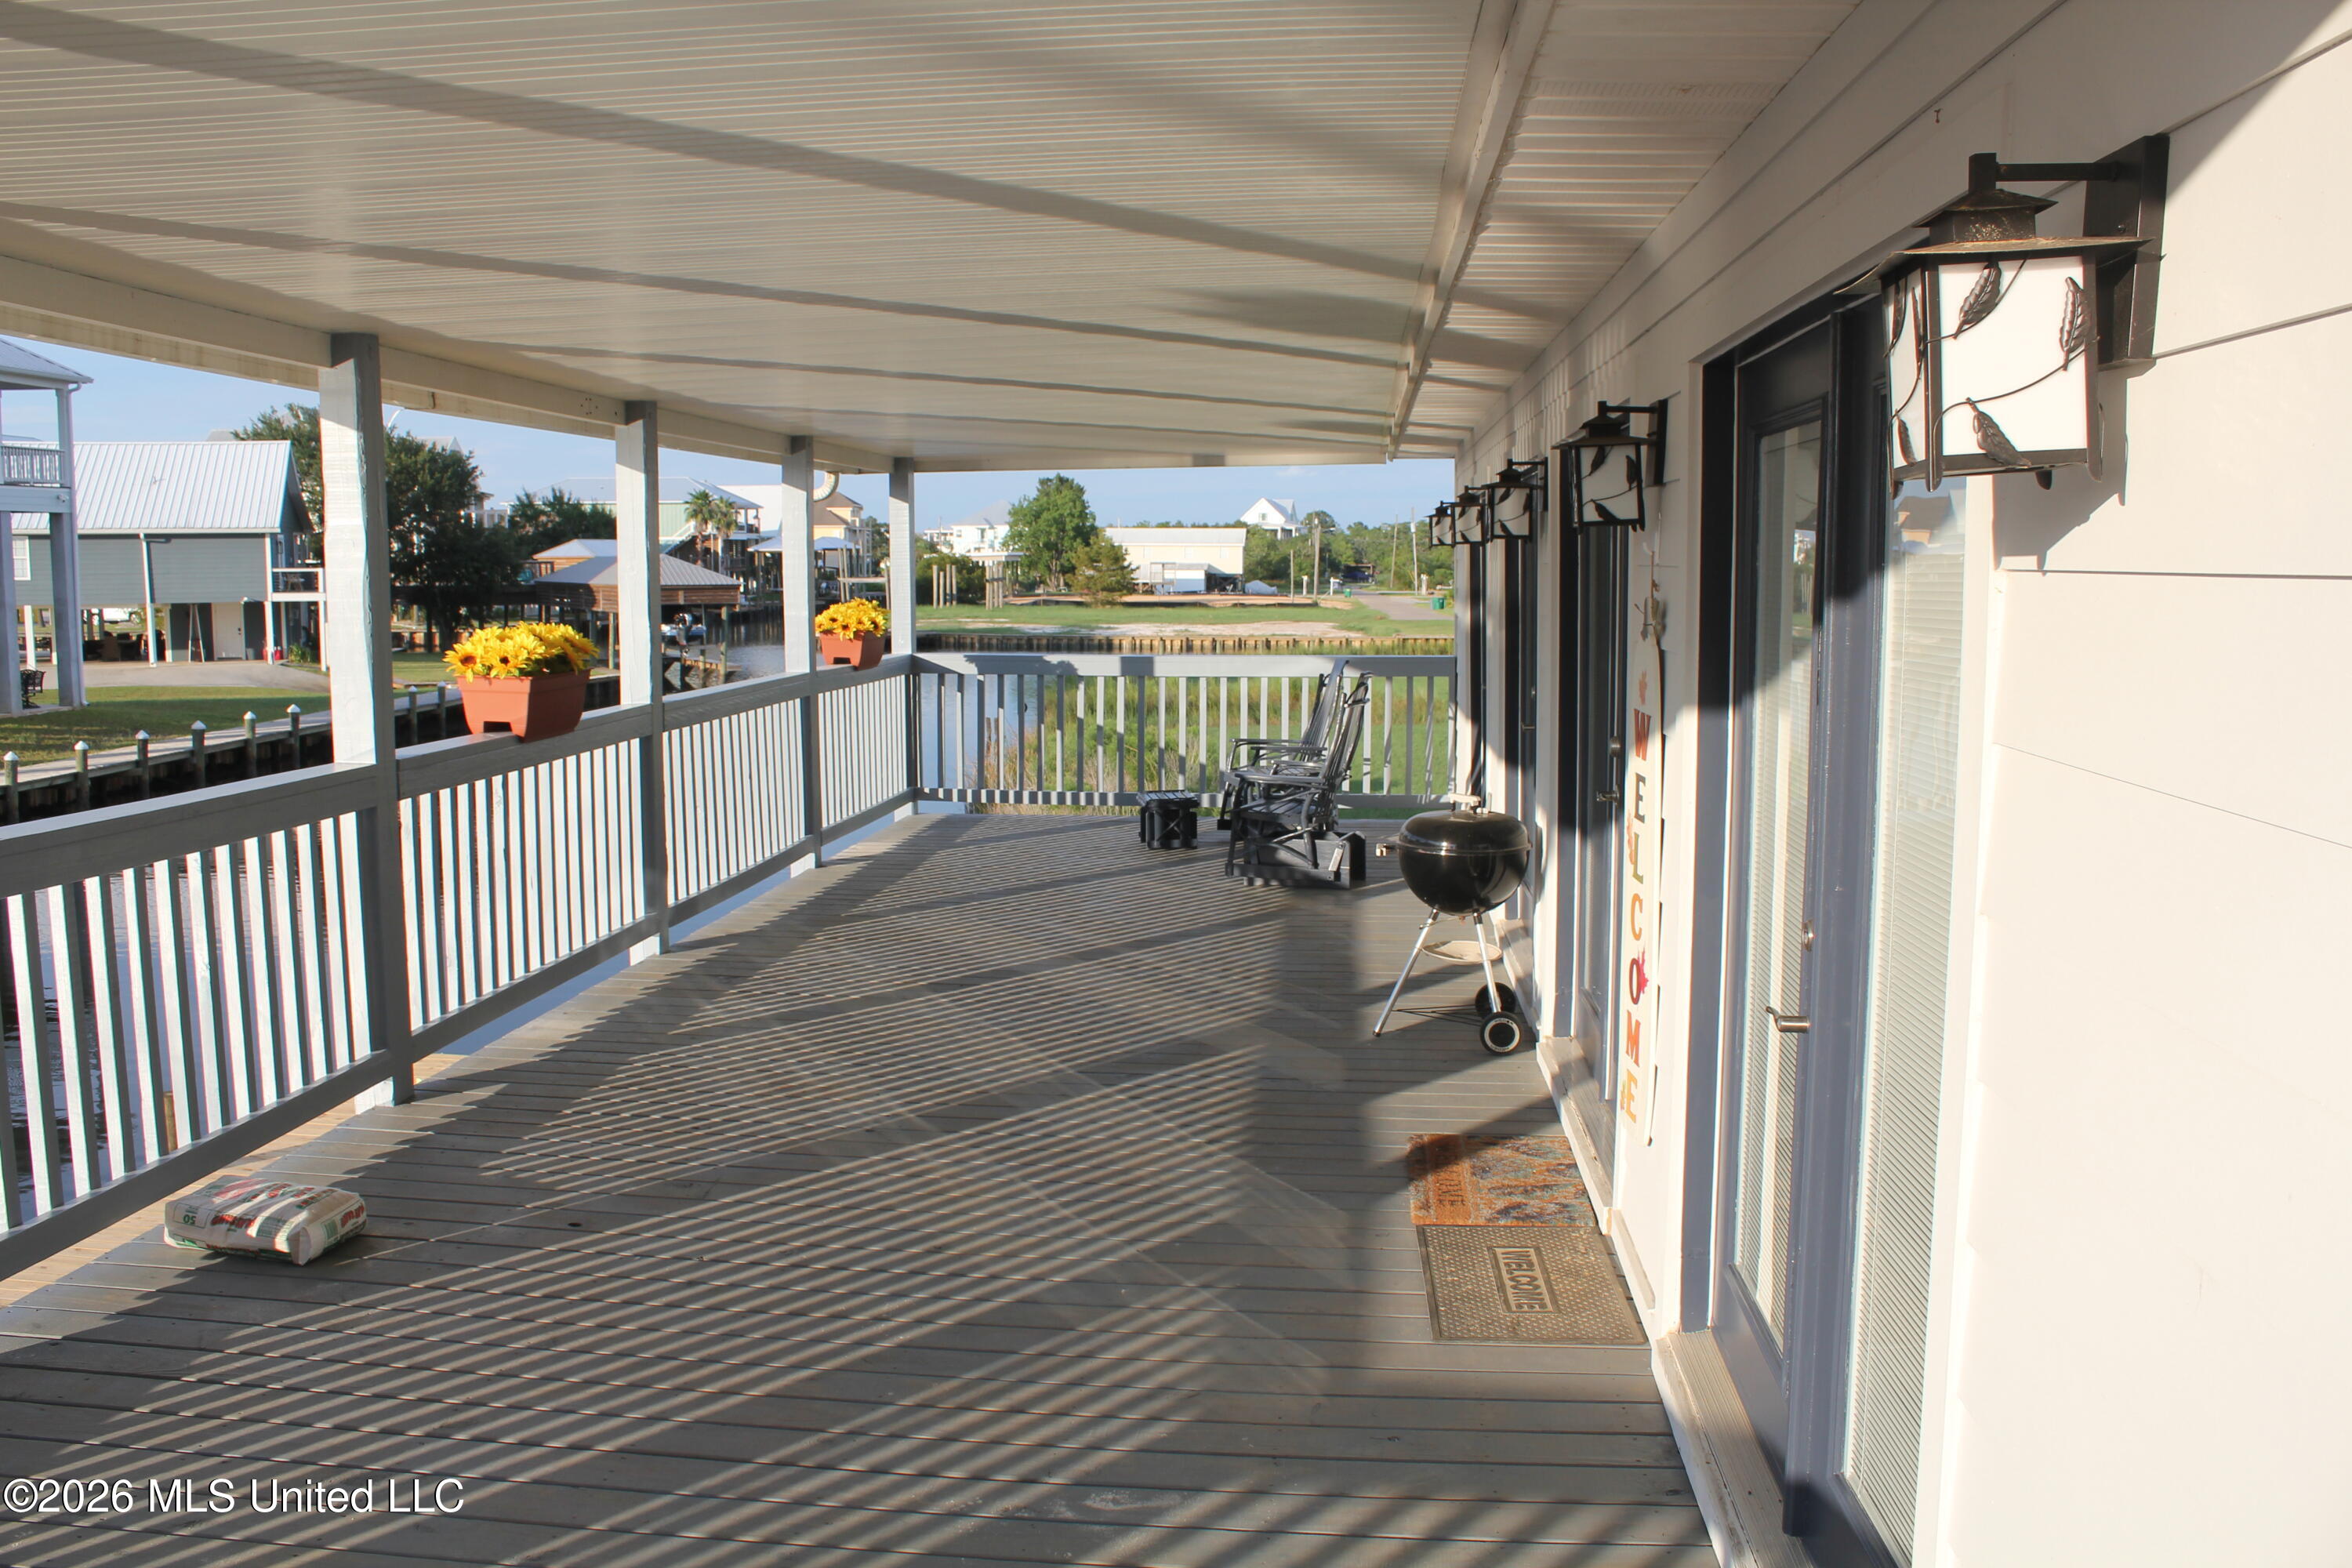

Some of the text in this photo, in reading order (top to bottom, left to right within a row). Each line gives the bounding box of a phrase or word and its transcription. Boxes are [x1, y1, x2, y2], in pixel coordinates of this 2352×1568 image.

[1624, 708, 1652, 1123] WELCOME
[183, 1214, 196, 1225] 50
[1501, 1250, 1549, 1311] WELCOME
